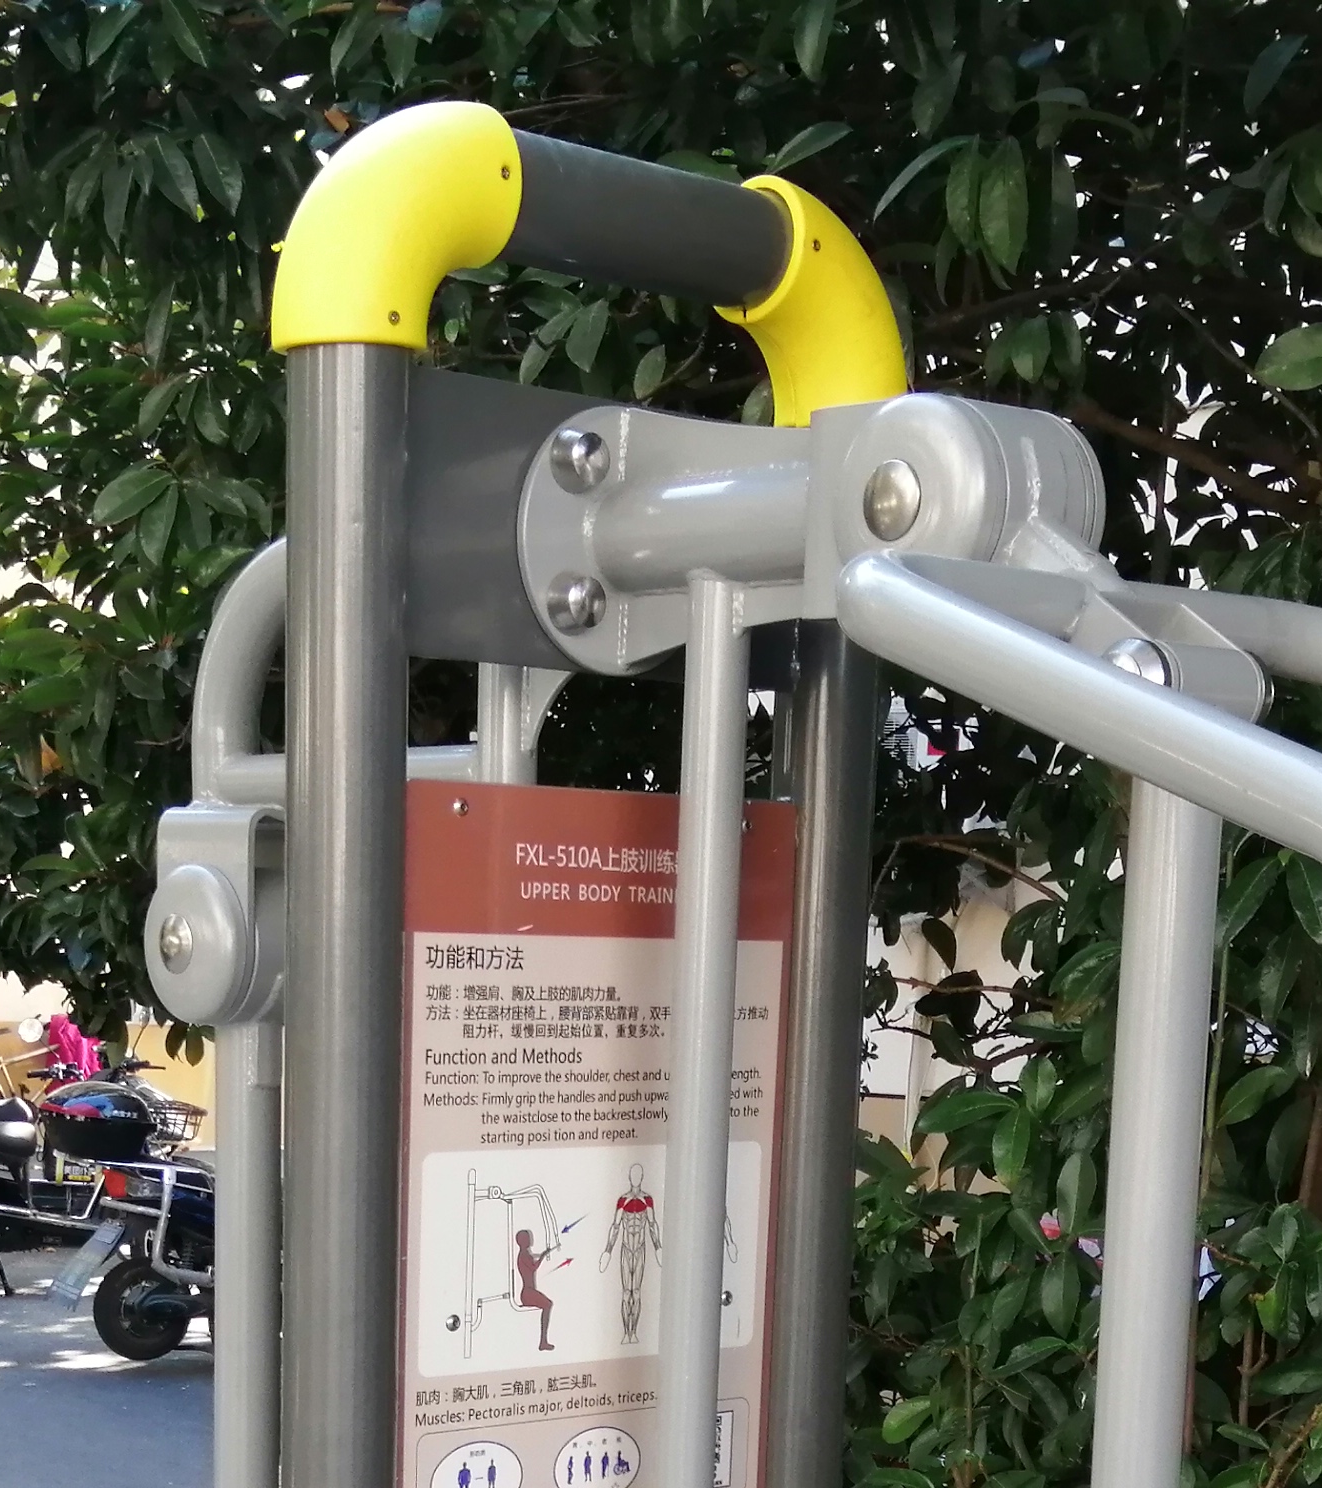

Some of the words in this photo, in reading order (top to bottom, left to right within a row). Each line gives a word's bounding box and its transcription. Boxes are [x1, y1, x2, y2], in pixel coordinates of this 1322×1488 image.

[516, 843, 678, 874] FXL-510A上肢训练
[521, 882, 570, 900] UPPER
[579, 884, 621, 902] BODY
[628, 886, 676, 904] TRAIN
[426, 944, 524, 970] 功能和方法
[734, 1006, 769, 1020] 方推动
[425, 1048, 487, 1065] Function
[491, 1048, 517, 1064] and
[522, 1047, 582, 1064] Methods
[425, 1071, 478, 1085] Function:
[482, 1071, 495, 1084] To
[499, 1071, 541, 1087] improve
[545, 1070, 562, 1082] the
[564, 1069, 611, 1083] shoulder,
[614, 1070, 639, 1081] chest
[643, 1069, 661, 1081] and
[731, 1067, 761, 1082] ength.
[423, 1092, 478, 1106] Methods:
[482, 1092, 514, 1108] Firmly
[516, 1092, 536, 1108] grip
[539, 1091, 555, 1104] the
[557, 1090, 596, 1103] handles
[598, 1091, 616, 1102] and
[618, 1091, 641, 1104] push
[644, 1093, 668, 1104] upwa
[743, 1087, 763, 1099] with
[481, 1111, 499, 1124] the
[503, 1110, 558, 1123] waistclose
[561, 1111, 571, 1122] to
[574, 1110, 591, 1122] the
[743, 1106, 759, 1117] the
[481, 1130, 524, 1146] starting
[579, 1129, 598, 1140] and
[602, 1128, 638, 1142] repeat.
[415, 1412, 464, 1427] Muscles:
[468, 1403, 525, 1421] Pectoralis
[528, 1400, 563, 1416] major,
[566, 1394, 615, 1411] deltoids,
[618, 1390, 658, 1405] triceps.
